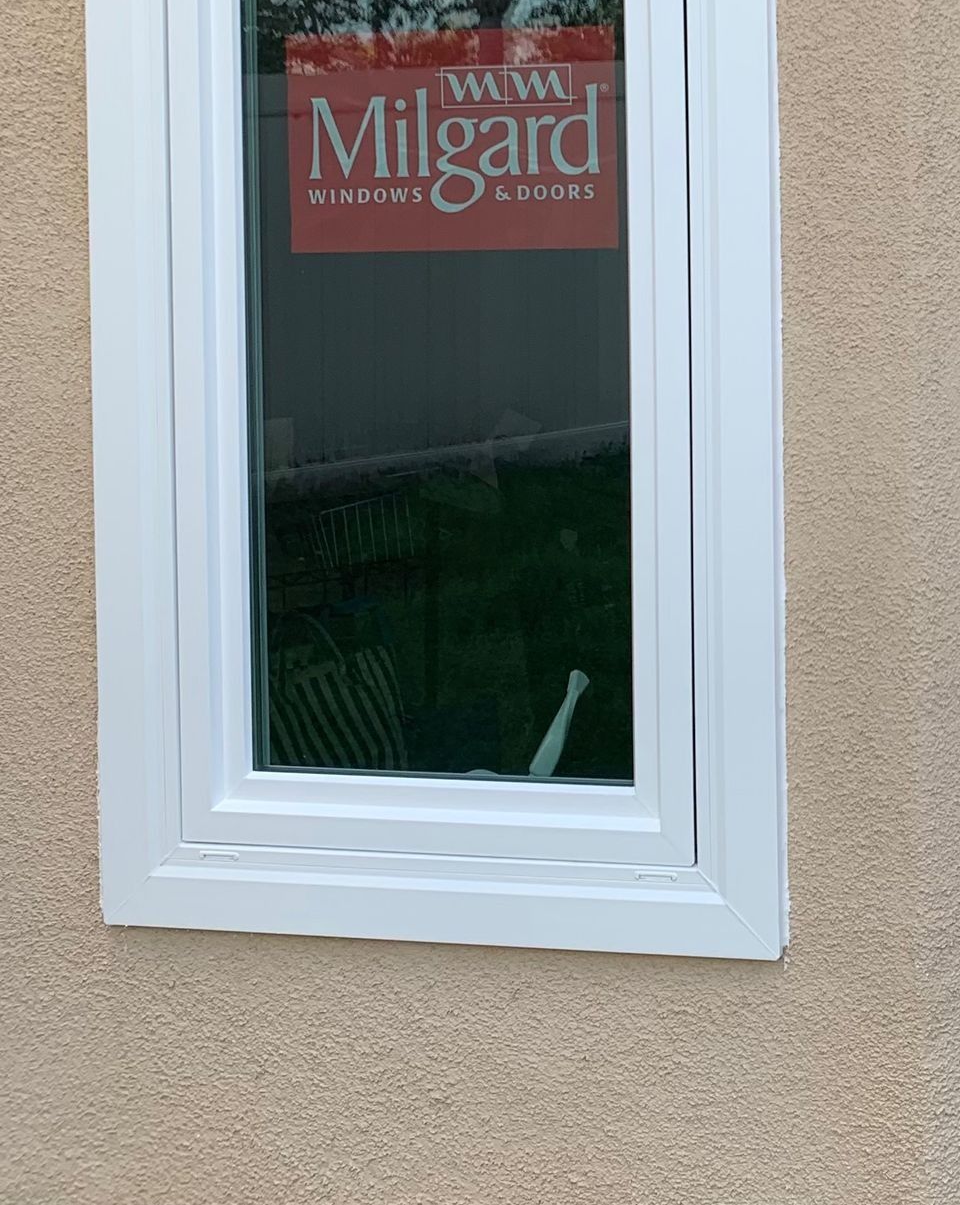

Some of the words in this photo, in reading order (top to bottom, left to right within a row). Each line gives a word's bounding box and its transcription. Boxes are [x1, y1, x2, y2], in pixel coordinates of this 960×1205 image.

[309, 82, 600, 213] Milgard
[308, 187, 424, 205] WINDOWS
[495, 184, 511, 202] &
[517, 183, 595, 201] DOORS
